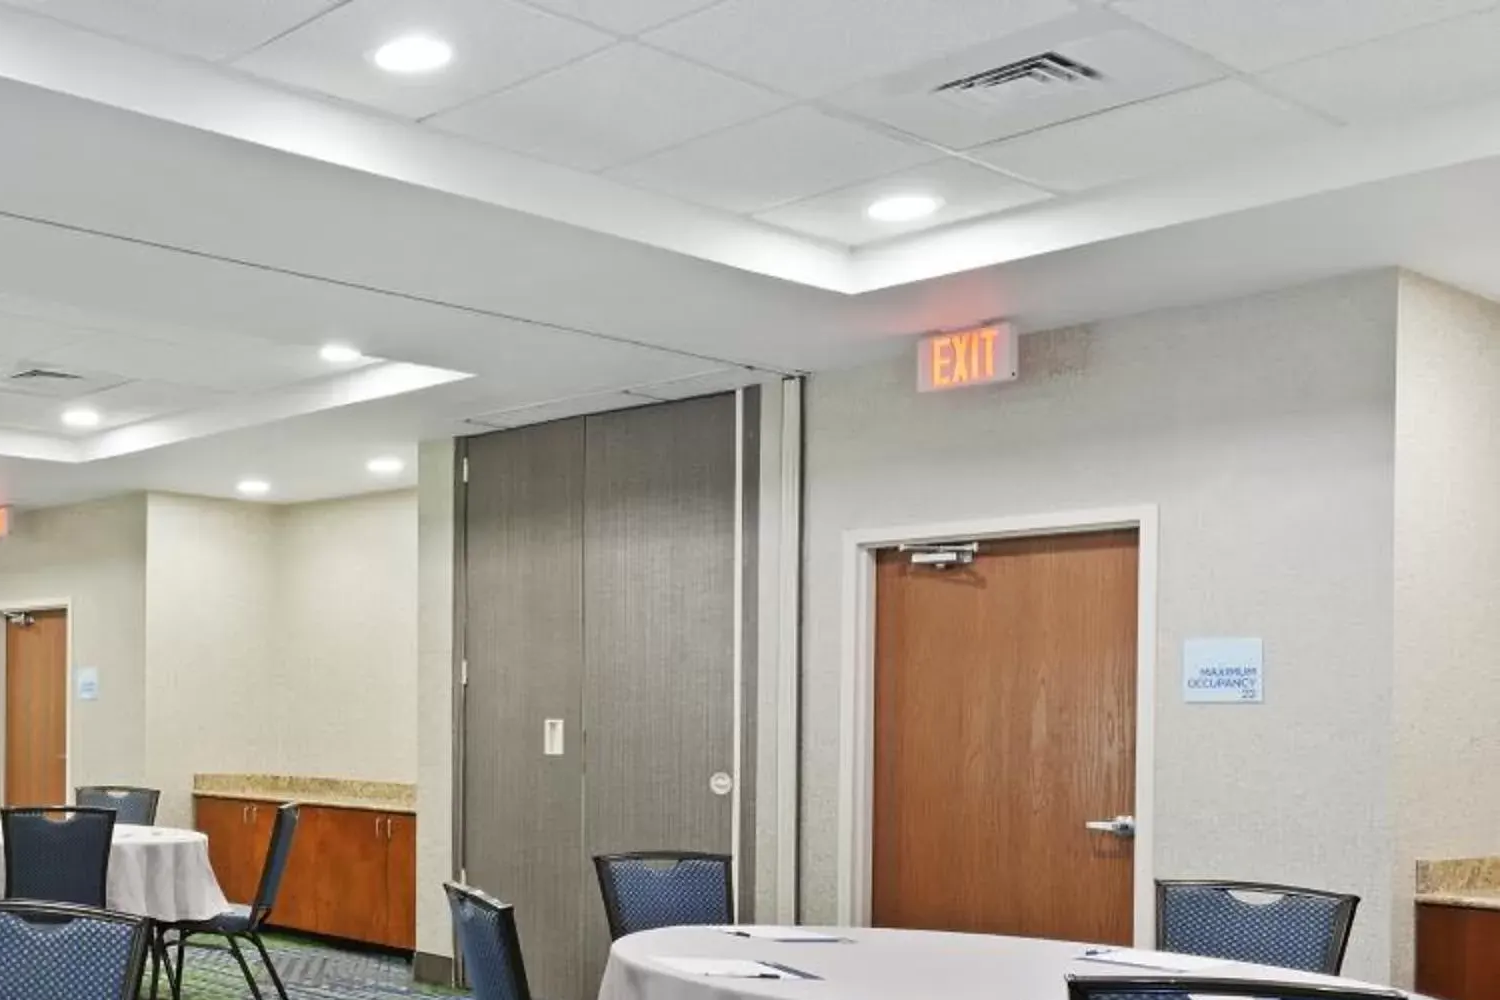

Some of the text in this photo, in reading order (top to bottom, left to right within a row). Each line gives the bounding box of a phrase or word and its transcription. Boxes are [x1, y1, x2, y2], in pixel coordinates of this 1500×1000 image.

[932, 329, 998, 386] EXIT
[1199, 667, 1257, 677] MAXIMUM
[1187, 678, 1256, 689] OCCUPANCY
